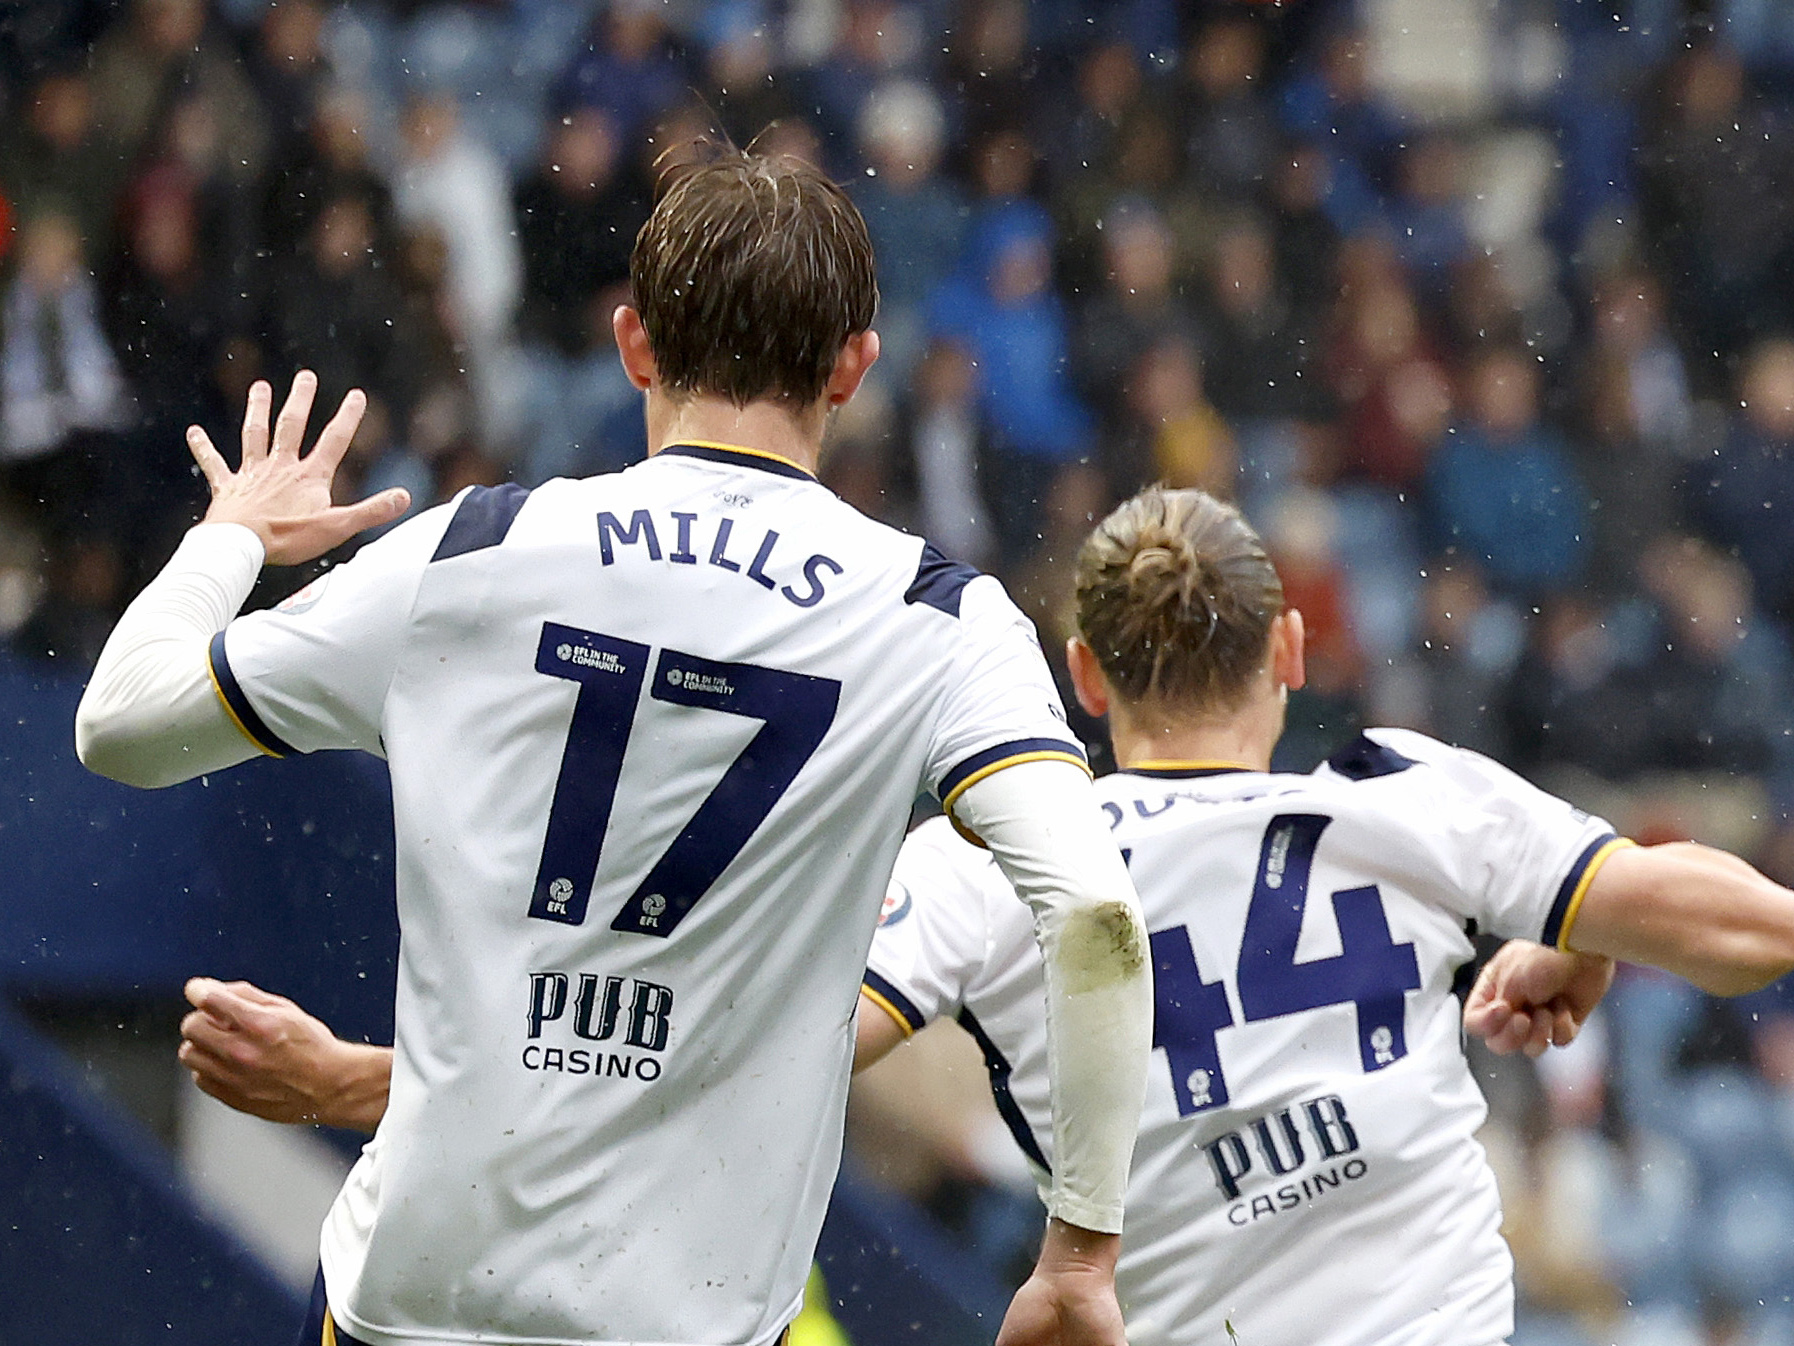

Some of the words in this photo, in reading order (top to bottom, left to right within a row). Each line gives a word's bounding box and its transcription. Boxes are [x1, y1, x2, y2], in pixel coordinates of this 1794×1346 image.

[596, 509, 844, 609] MILLS
[572, 656, 626, 673] COMMUNITY
[590, 649, 601, 659] IN
[602, 651, 620, 663] THE
[527, 620, 842, 939] 17
[547, 900, 567, 915] EFL
[639, 915, 659, 928] EFL
[527, 972, 674, 1052] PUB
[522, 1045, 662, 1081] CASINO
[1202, 1094, 1360, 1201] PUB
[1228, 1159, 1368, 1226] CASINO
